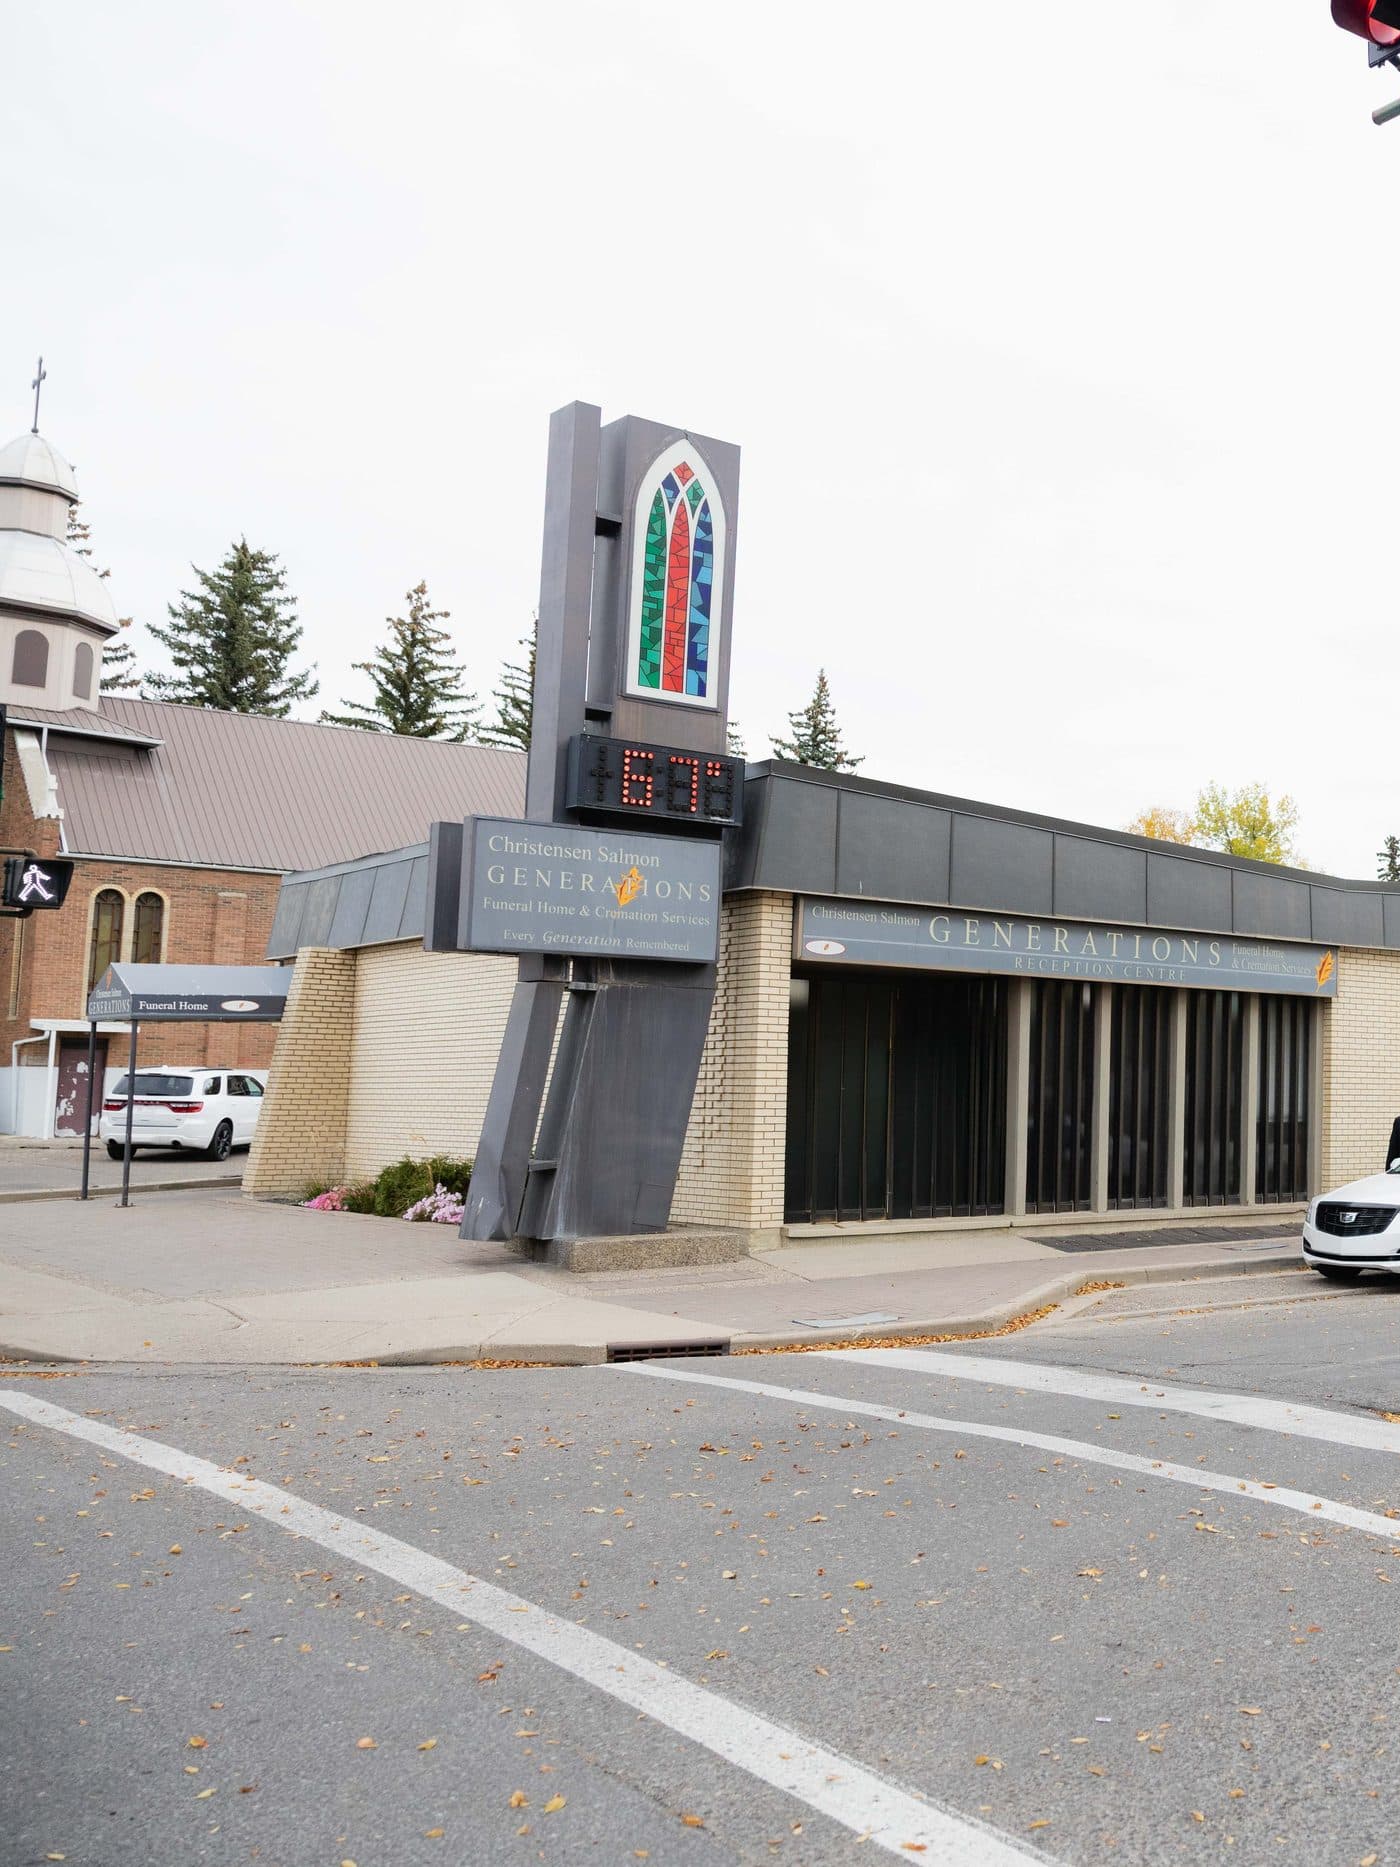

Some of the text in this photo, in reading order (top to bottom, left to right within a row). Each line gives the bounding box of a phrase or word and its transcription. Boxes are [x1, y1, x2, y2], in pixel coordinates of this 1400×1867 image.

[488, 834, 660, 867] Christensen Salmon
[487, 865, 712, 902] GENERATIONS
[483, 896, 711, 926] Funeral Home & Cremation Services
[811, 905, 921, 927] Christensen Salmon
[503, 929, 690, 952] Every Generation Remembered
[929, 915, 1222, 966] GENERATIONS
[1232, 943, 1285, 959] Funeral Home
[1014, 956, 1114, 976] RECEPTION
[1231, 957, 1240, 969] &
[1240, 958, 1279, 973] Cremation
[138, 1000, 209, 1011] Funeral Home
